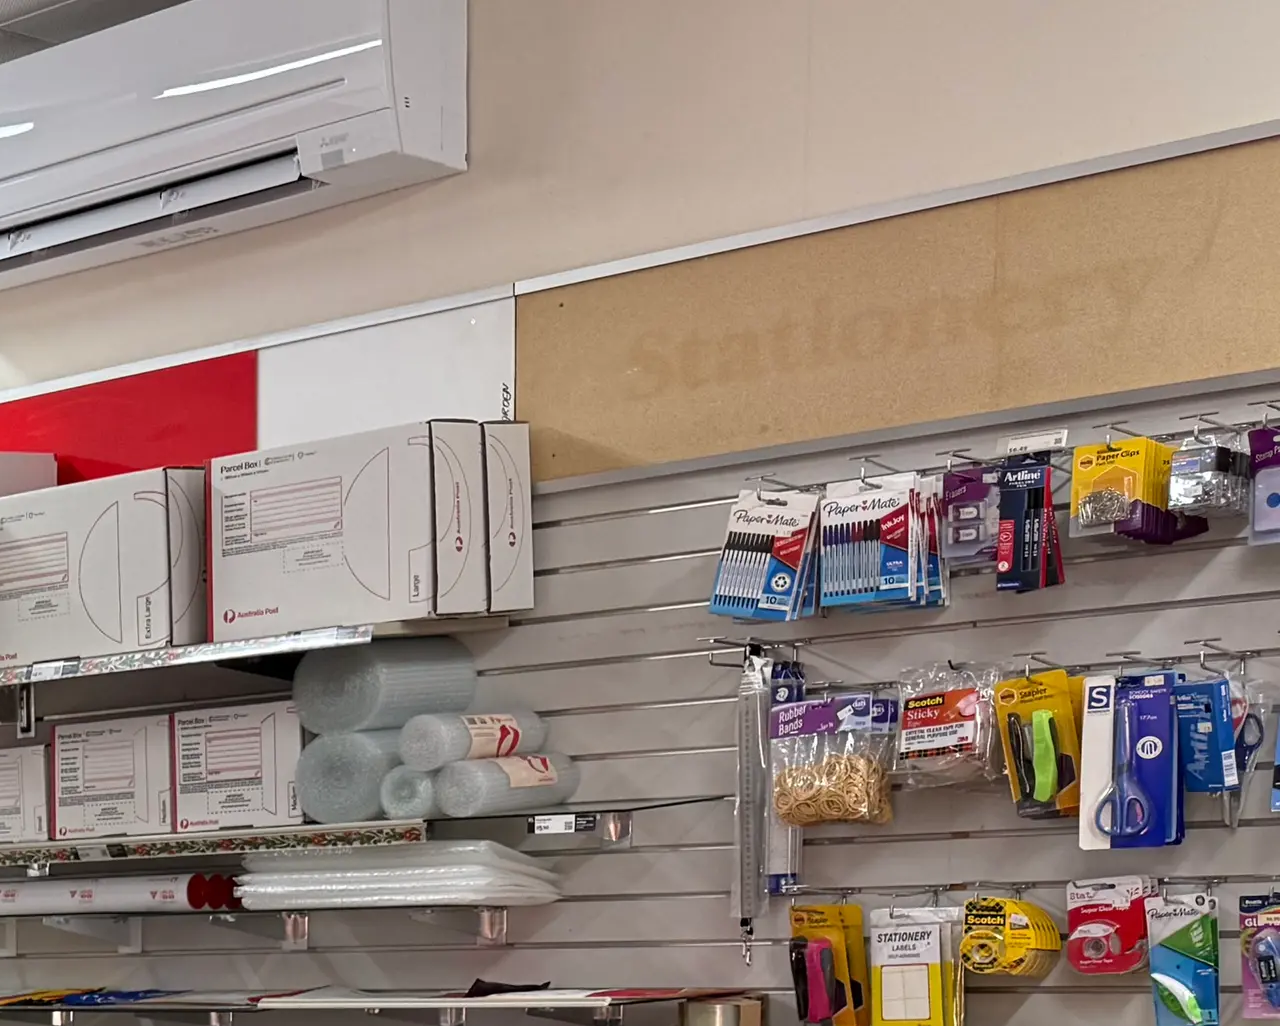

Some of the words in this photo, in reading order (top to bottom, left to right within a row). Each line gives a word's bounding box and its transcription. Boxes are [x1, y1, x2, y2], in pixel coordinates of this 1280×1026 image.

[1097, 451, 1119, 461] Paper
[1121, 449, 1139, 458] Clips
[220, 461, 243, 474] Parcel
[244, 460, 257, 468] Box
[1004, 470, 1040, 482] Artline
[823, 502, 862, 517] Paper
[867, 498, 899, 511] Mate
[734, 511, 766, 525] Paper
[771, 514, 800, 527] Mate
[884, 577, 895, 585] 10
[766, 596, 777, 604] 10
[237, 609, 264, 618] Australia
[266, 607, 278, 615] Post
[1019, 687, 1047, 699] Stapler
[1091, 688, 1108, 706] S
[908, 697, 943, 708] Scotch
[779, 705, 806, 723] Rubber
[907, 708, 939, 721] Sticky
[779, 719, 803, 736] Bands
[967, 916, 1004, 925] Scotch
[1147, 909, 1172, 921] Paper
[877, 931, 931, 943] STATIONERY
